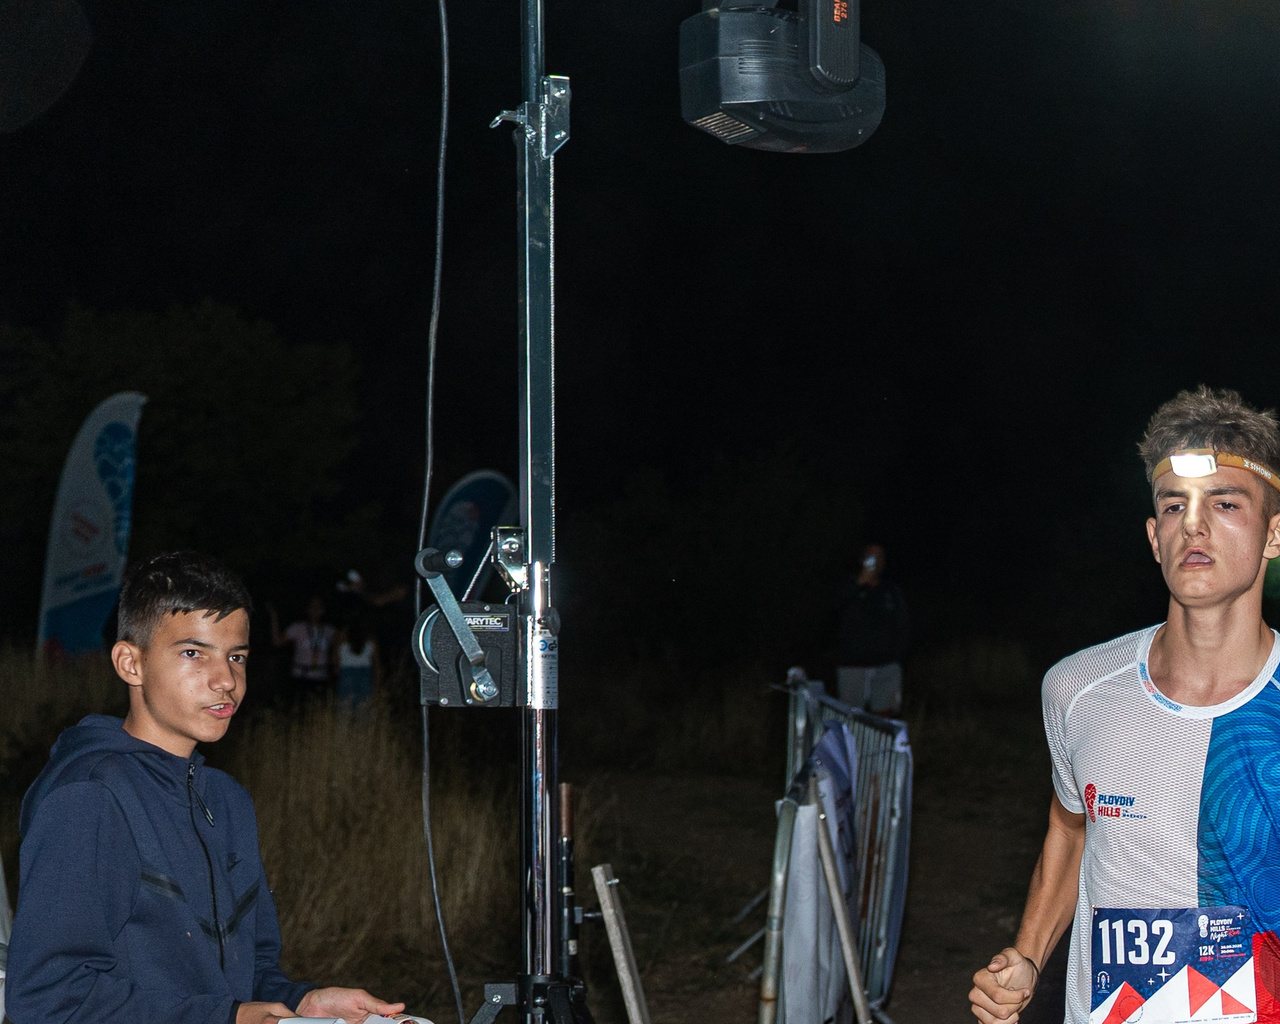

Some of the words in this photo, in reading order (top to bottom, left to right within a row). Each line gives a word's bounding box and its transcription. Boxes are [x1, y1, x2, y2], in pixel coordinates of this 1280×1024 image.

[1098, 794, 1135, 806] PLOVDIV
[1097, 806, 1121, 818] HILLS
[1098, 918, 1176, 966] 1132
[1199, 945, 1215, 956] 12K
